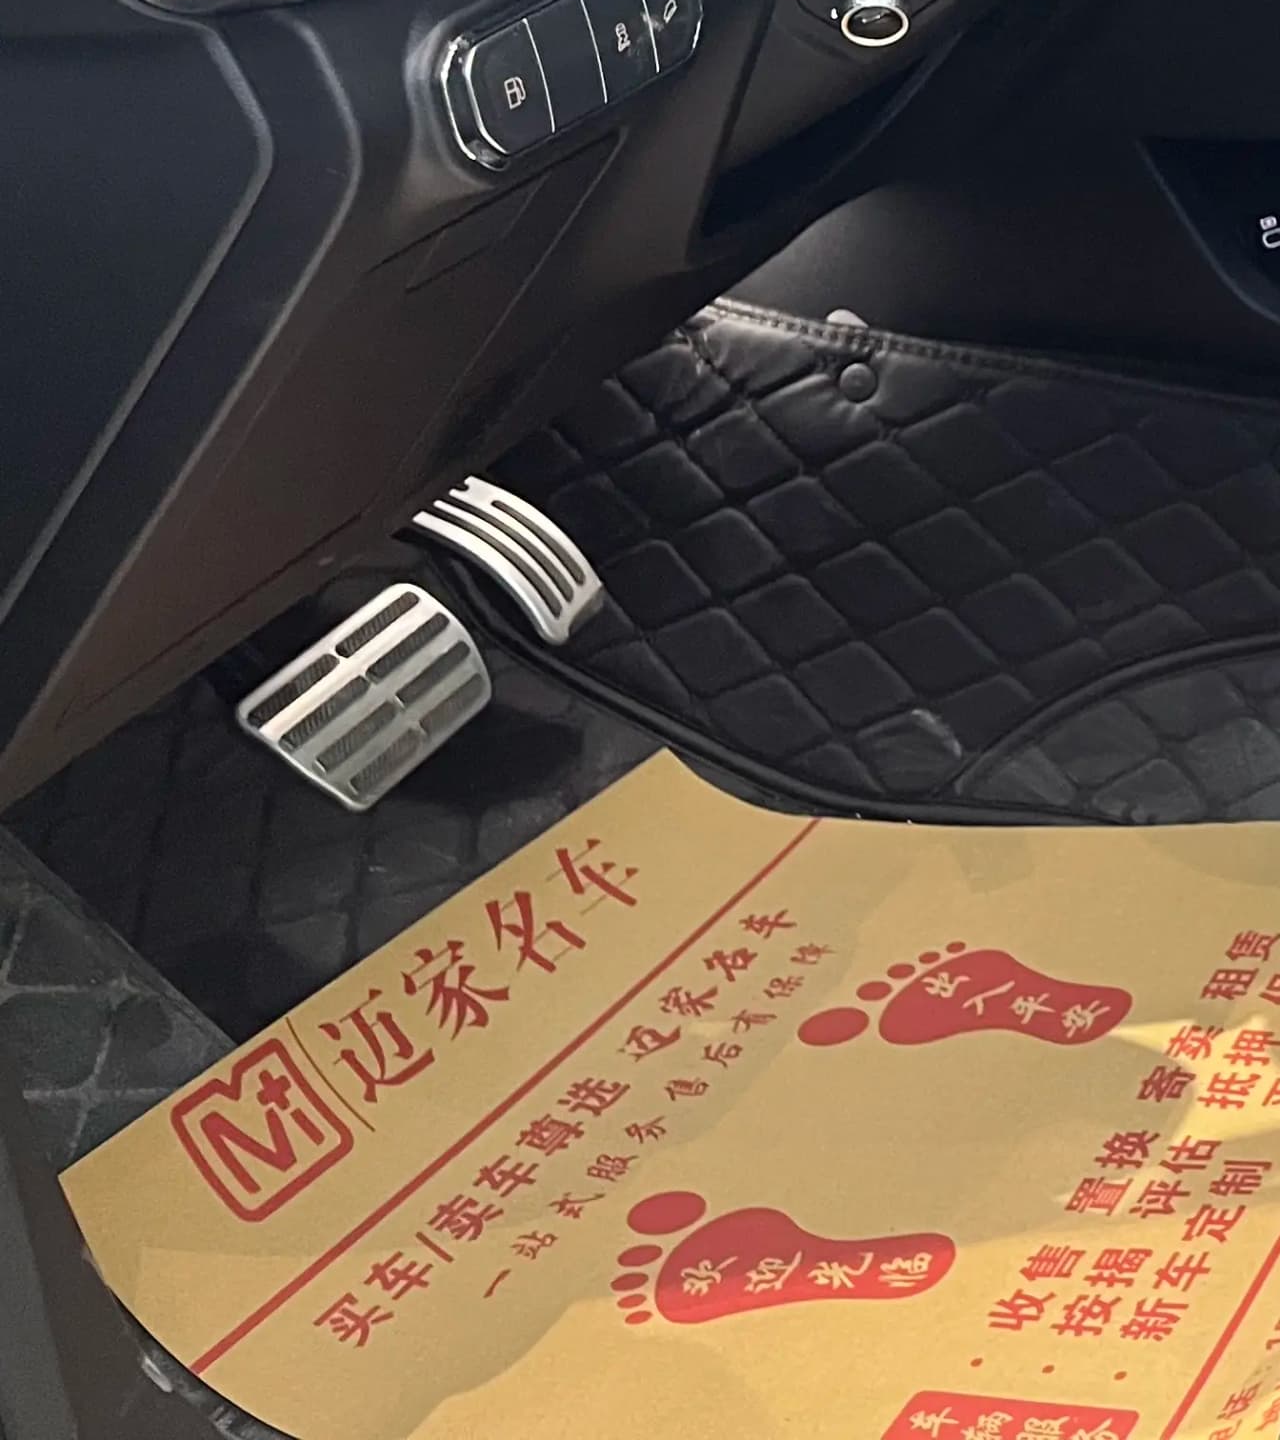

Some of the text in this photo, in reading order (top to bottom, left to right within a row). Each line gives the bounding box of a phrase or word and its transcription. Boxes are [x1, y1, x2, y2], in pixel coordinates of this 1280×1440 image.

[318, 837, 639, 1104] 迈家名车
[922, 972, 1111, 1038] 出入平安
[314, 1076, 630, 1347] 买车/卖车尊选
[1065, 1131, 1160, 1217] 置换
[1137, 1024, 1226, 1103] 寄卖
[681, 1250, 934, 1297] 欢迎光临
[1051, 1247, 1152, 1338] 按揭
[1129, 1135, 1222, 1219] 评估
[1119, 1159, 1272, 1342] 新车定制
